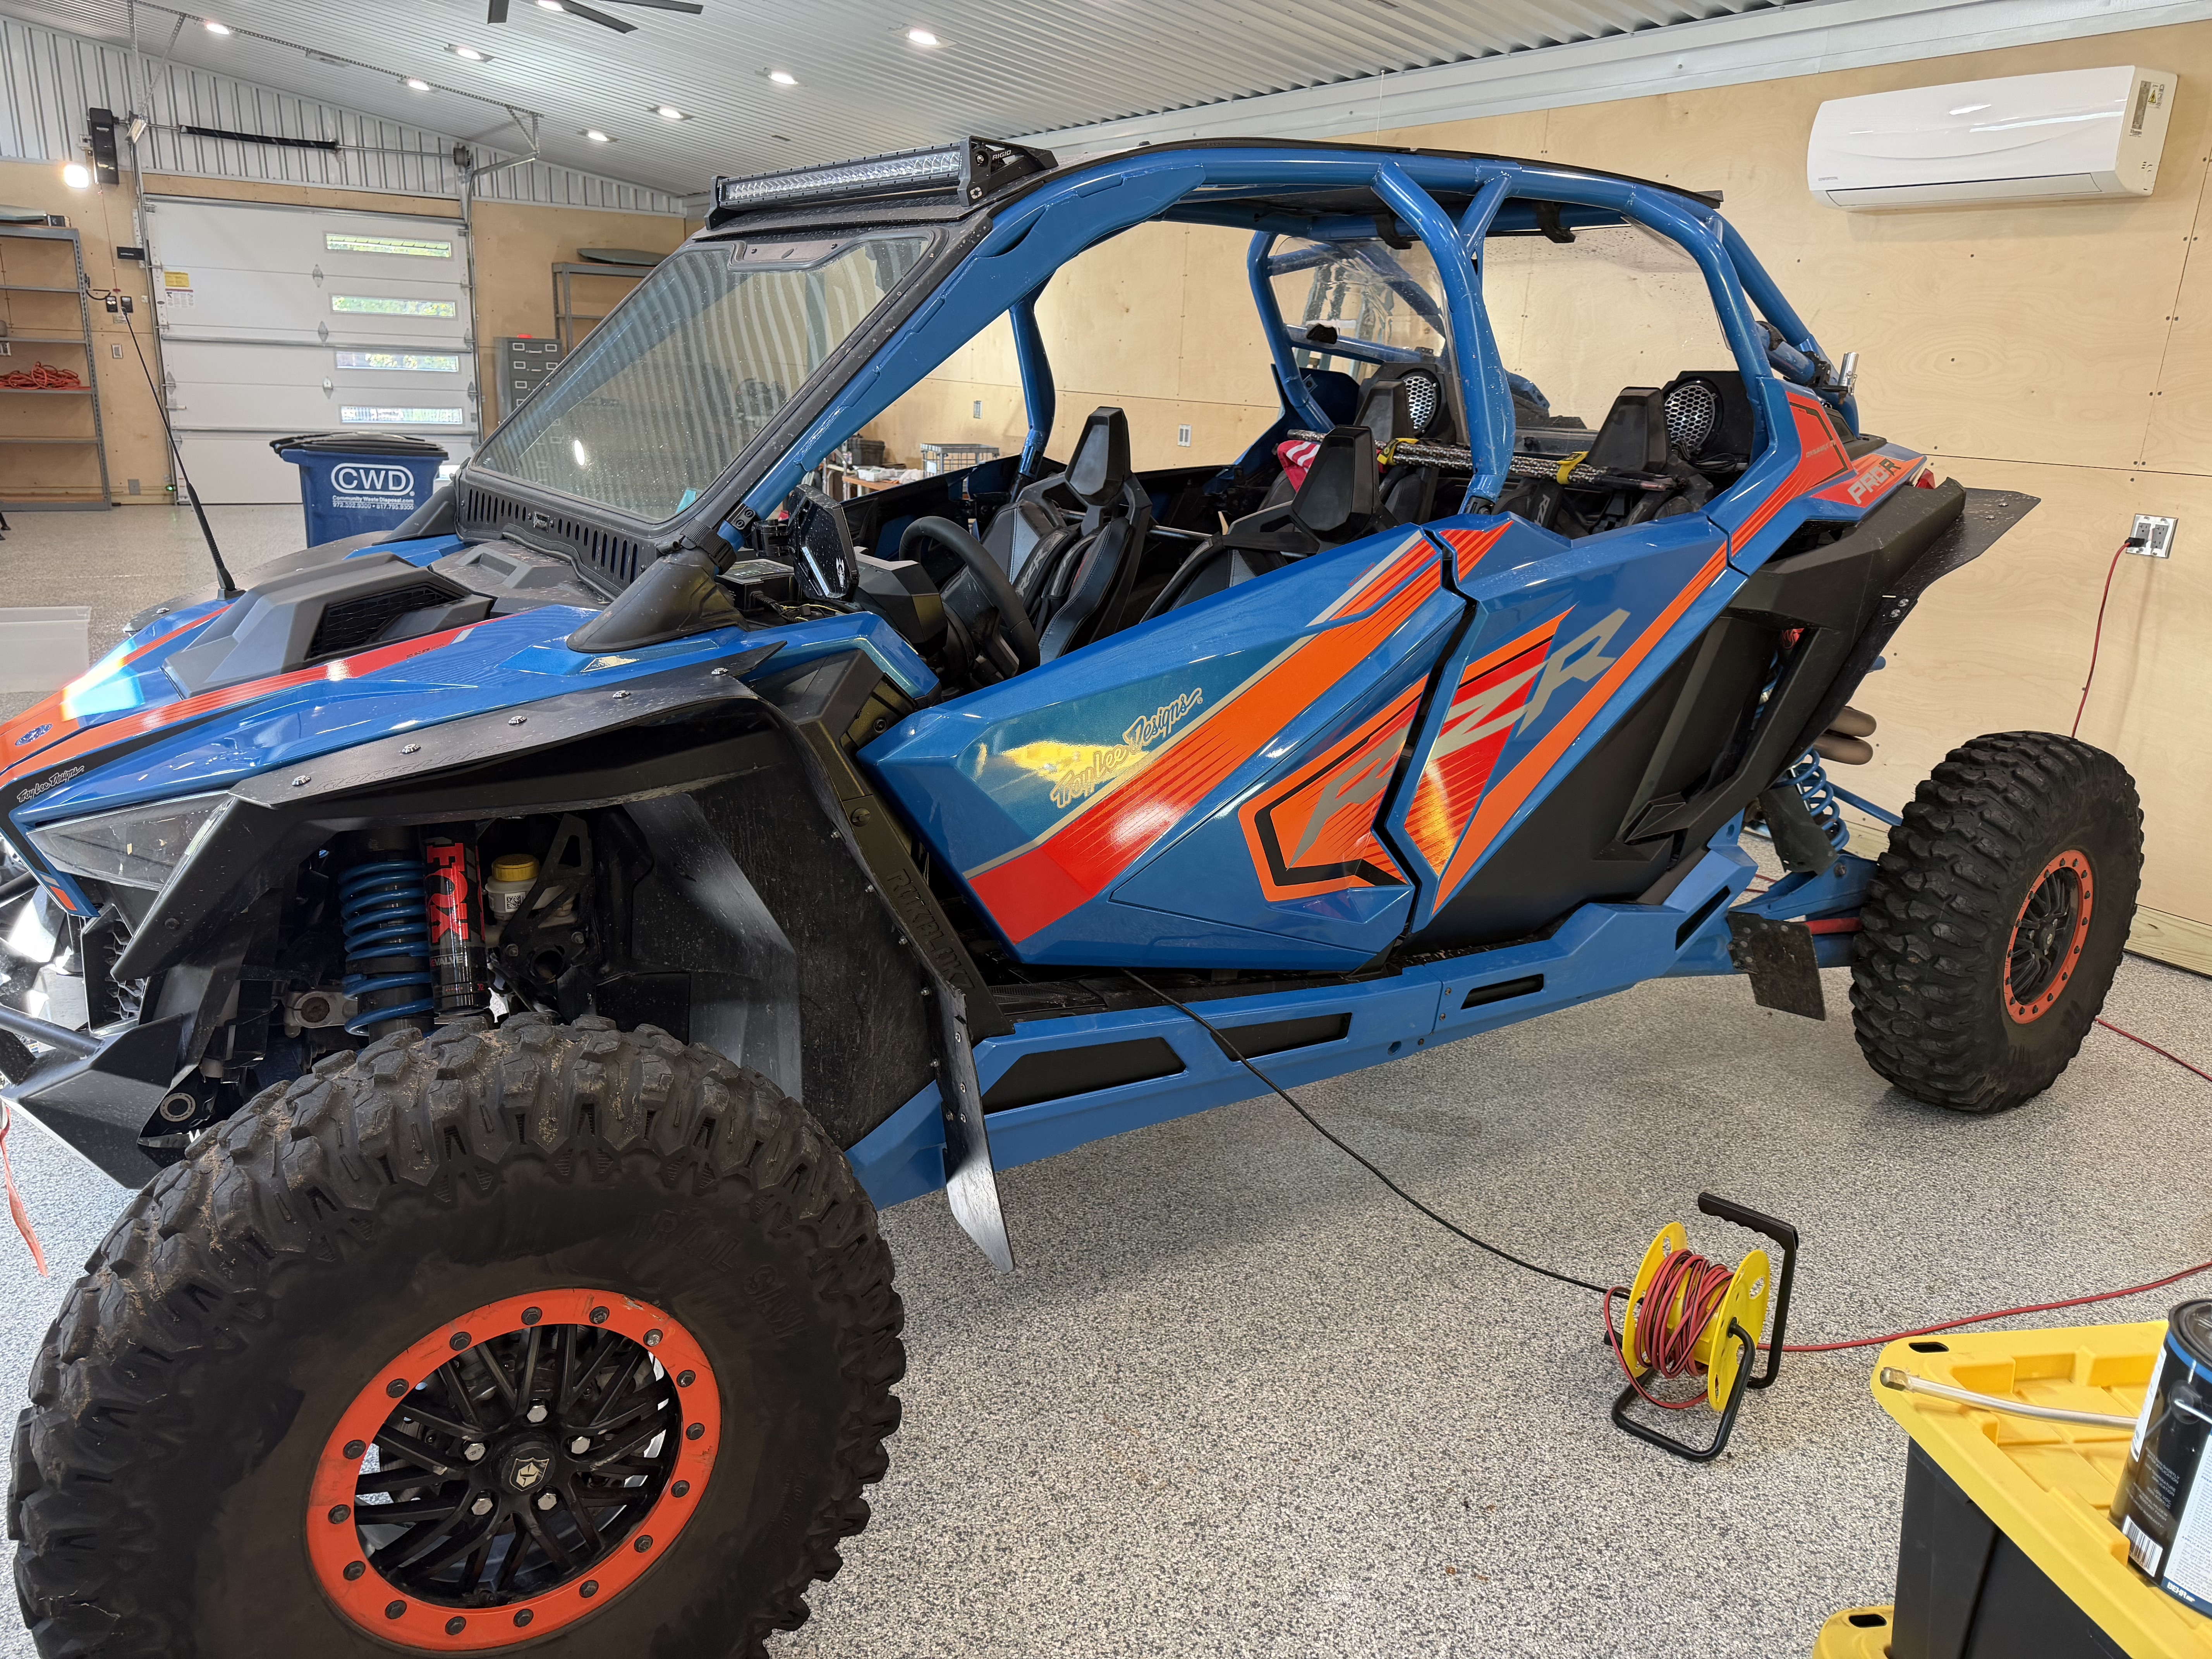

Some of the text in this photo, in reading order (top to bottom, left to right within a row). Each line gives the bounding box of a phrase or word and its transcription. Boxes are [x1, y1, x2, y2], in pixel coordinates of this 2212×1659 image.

[338, 468, 406, 491] CWD
[1847, 458, 1901, 505] PRO R
[332, 495, 363, 503] Community
[1050, 687, 1202, 809] Troy Lee Designs
[1286, 608, 1631, 870] RZR
[17, 765, 84, 802] Troy Lee Designs
[424, 843, 469, 944] FOX
[2182, 1535, 2211, 1554] APPLICATION
[2167, 1582, 2187, 1599] BEHR
